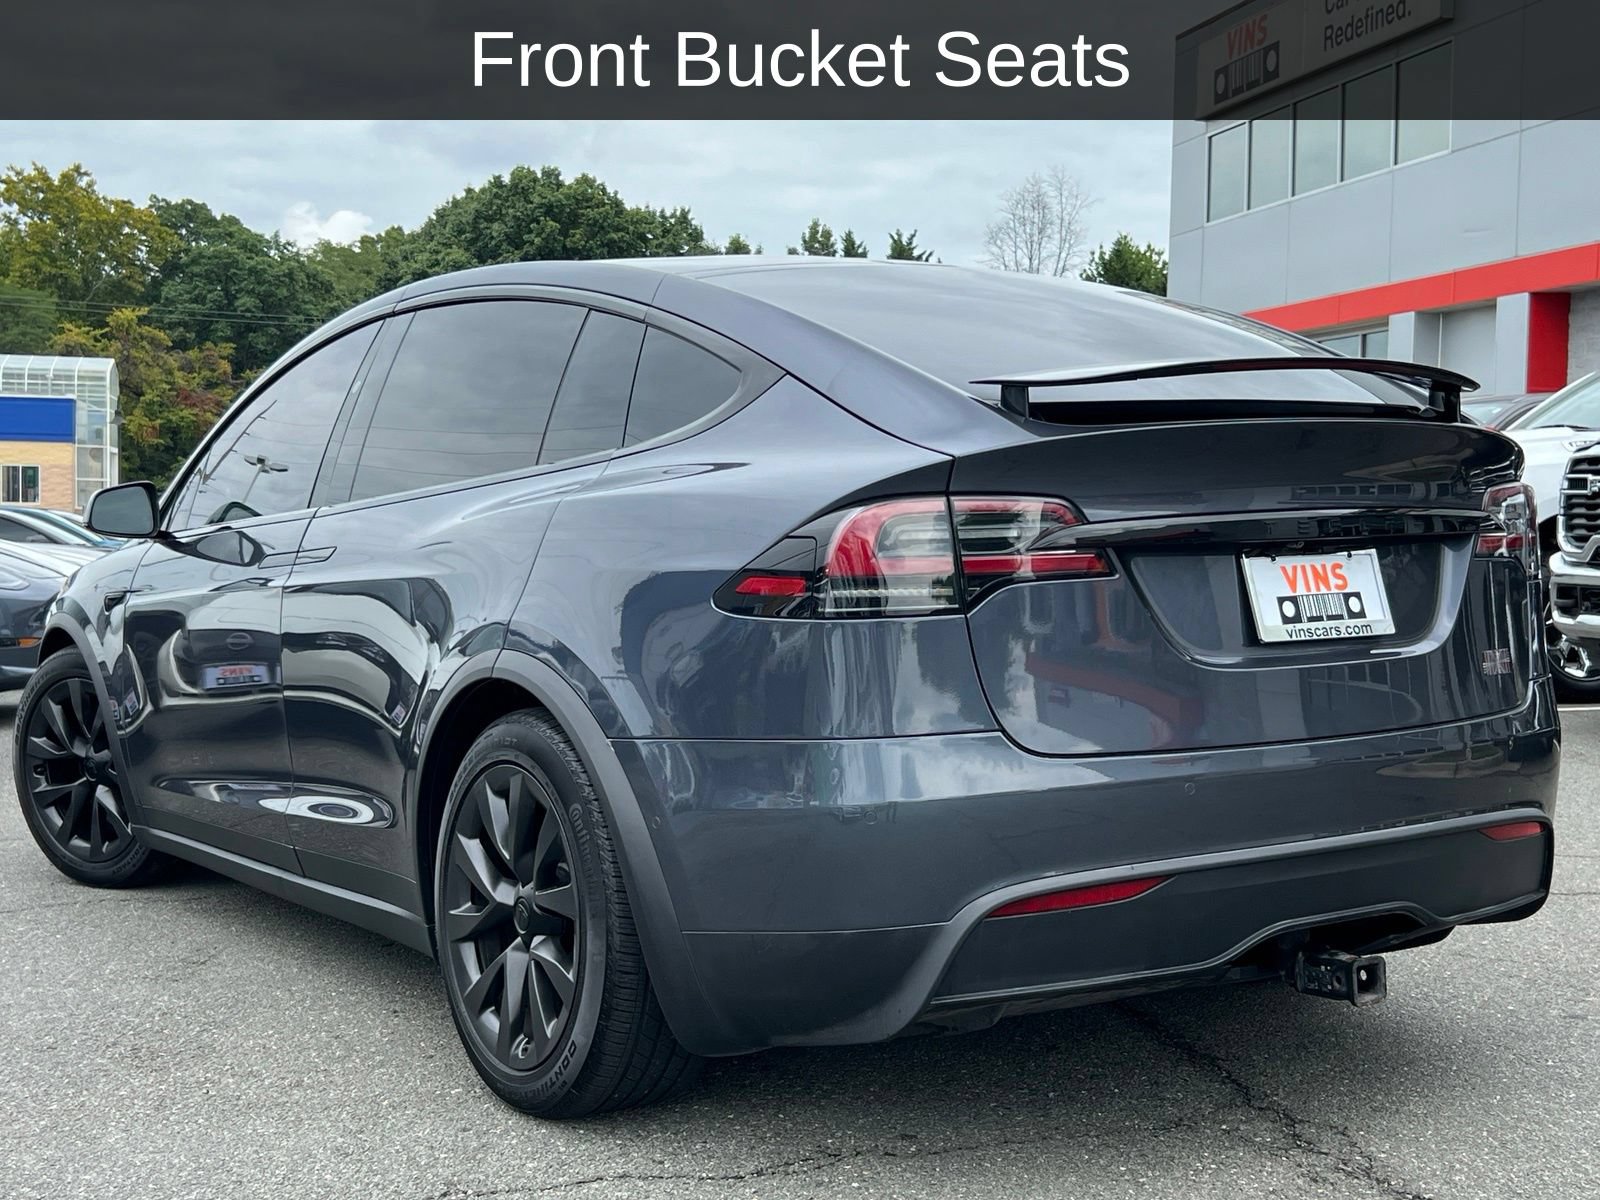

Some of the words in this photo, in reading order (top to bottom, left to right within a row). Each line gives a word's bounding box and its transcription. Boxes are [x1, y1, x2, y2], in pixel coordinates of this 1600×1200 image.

[1227, 14, 1268, 60] VINS
[1324, 0, 1411, 51] Redefined.
[1280, 562, 1349, 593] VINS
[1285, 622, 1373, 640] vinscars.com
